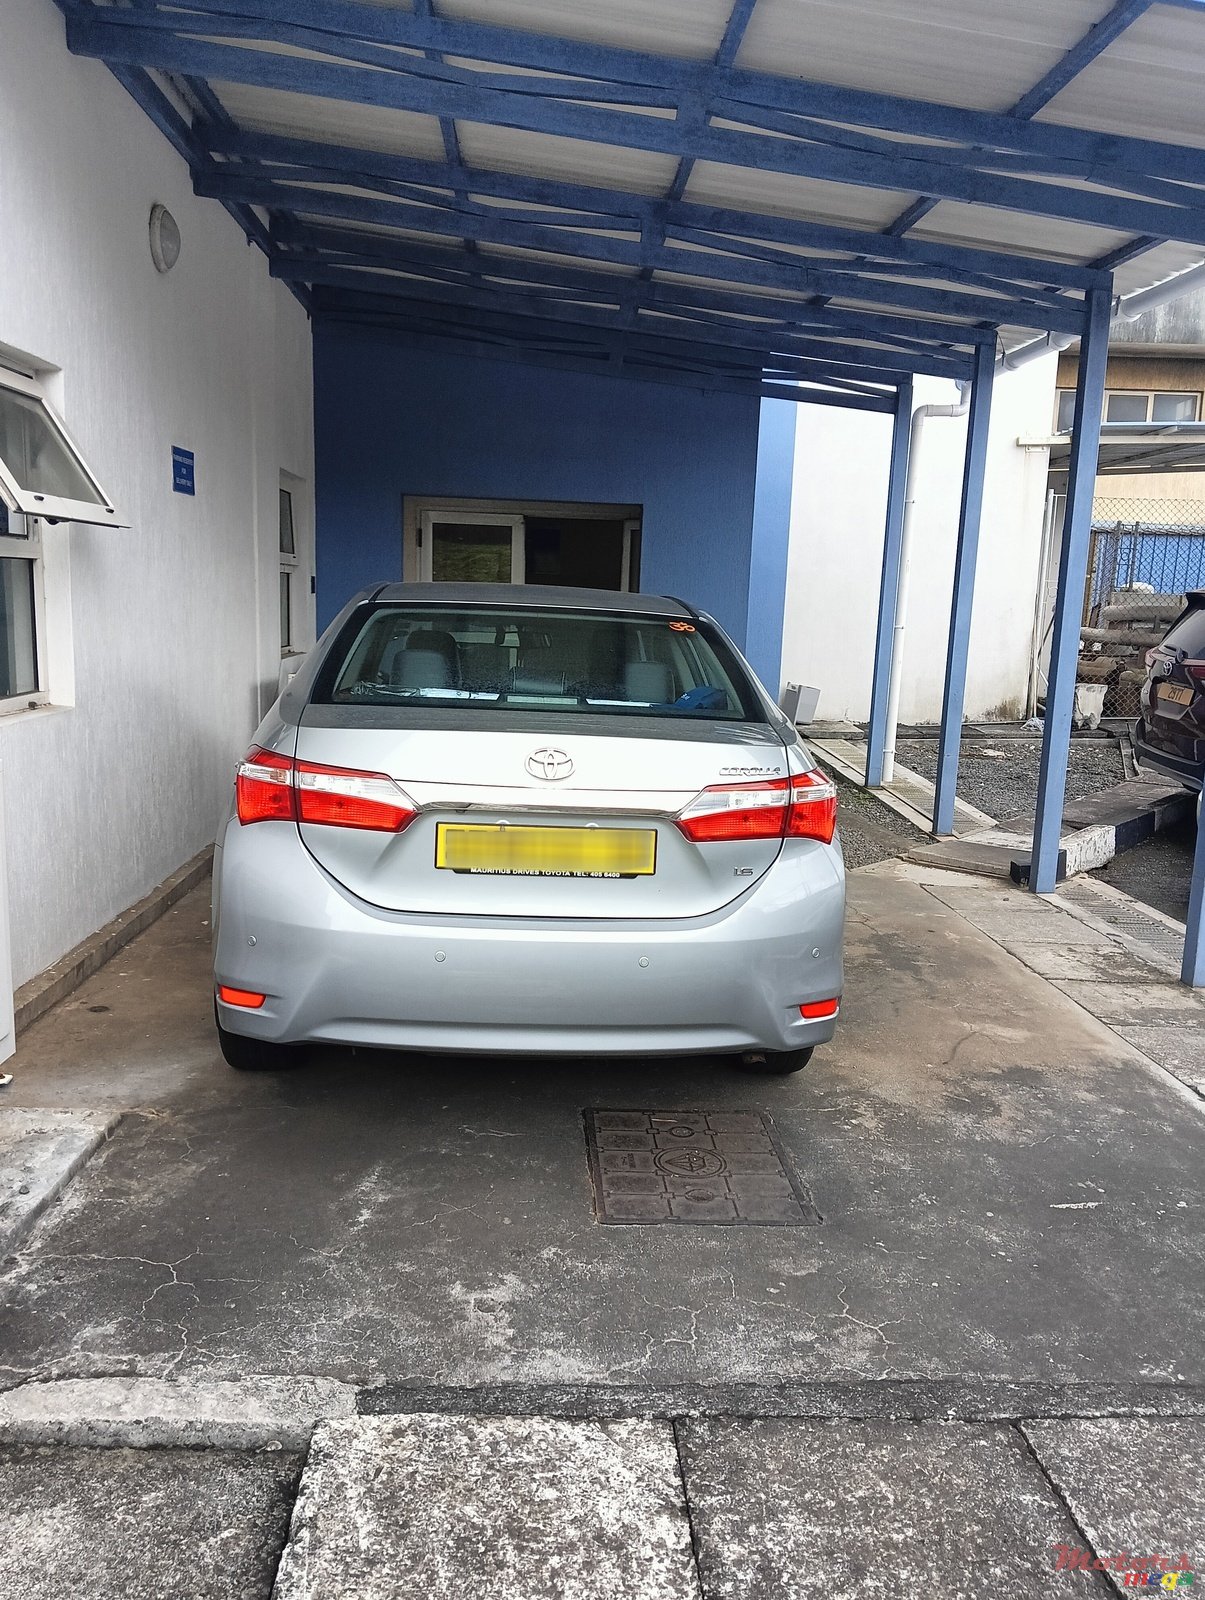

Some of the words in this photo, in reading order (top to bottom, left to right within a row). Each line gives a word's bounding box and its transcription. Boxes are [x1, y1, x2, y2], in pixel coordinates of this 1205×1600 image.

[719, 766, 781, 777] COROLLA
[470, 867, 511, 875] MAURITIUS
[512, 868, 540, 876] DRIVES
[541, 869, 571, 877] TOYOTA
